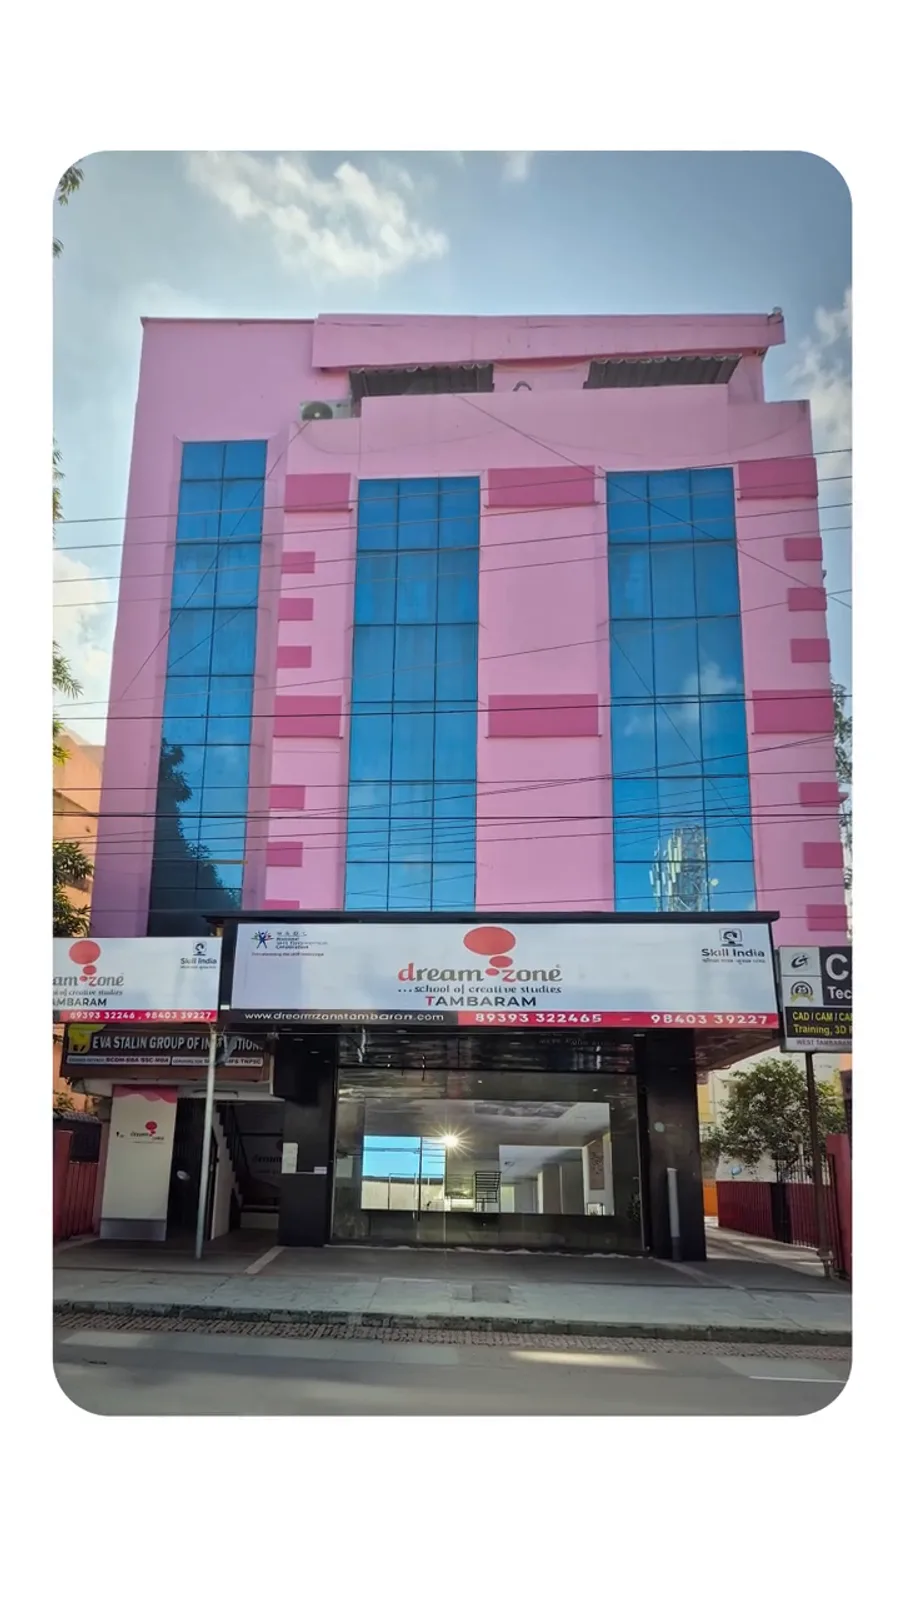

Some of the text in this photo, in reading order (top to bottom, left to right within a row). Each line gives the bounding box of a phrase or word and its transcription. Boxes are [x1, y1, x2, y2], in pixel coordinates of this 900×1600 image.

[701, 948, 765, 957] Skill India
[198, 957, 218, 965] India
[397, 962, 563, 983] dream zone
[88, 974, 125, 987] zone
[453, 985, 465, 995] of
[468, 985, 517, 994] creative
[520, 985, 563, 994] studies
[425, 996, 537, 1008] TAMBARAM
[180, 1011, 212, 1019] 39227
[475, 1013, 530, 1023] 89393
[535, 1013, 602, 1023] 322465
[650, 1014, 708, 1024] 98403
[713, 1014, 768, 1025] 39227
[792, 1011, 810, 1021] CAD
[815, 1012, 833, 1022] CAM
[793, 1024, 833, 1036] Training,
[834, 1025, 848, 1035] 3D
[92, 1035, 112, 1049] EVA
[112, 1035, 148, 1050] STALIN
[149, 1036, 184, 1050] GROUP
[186, 1037, 200, 1050] OF
